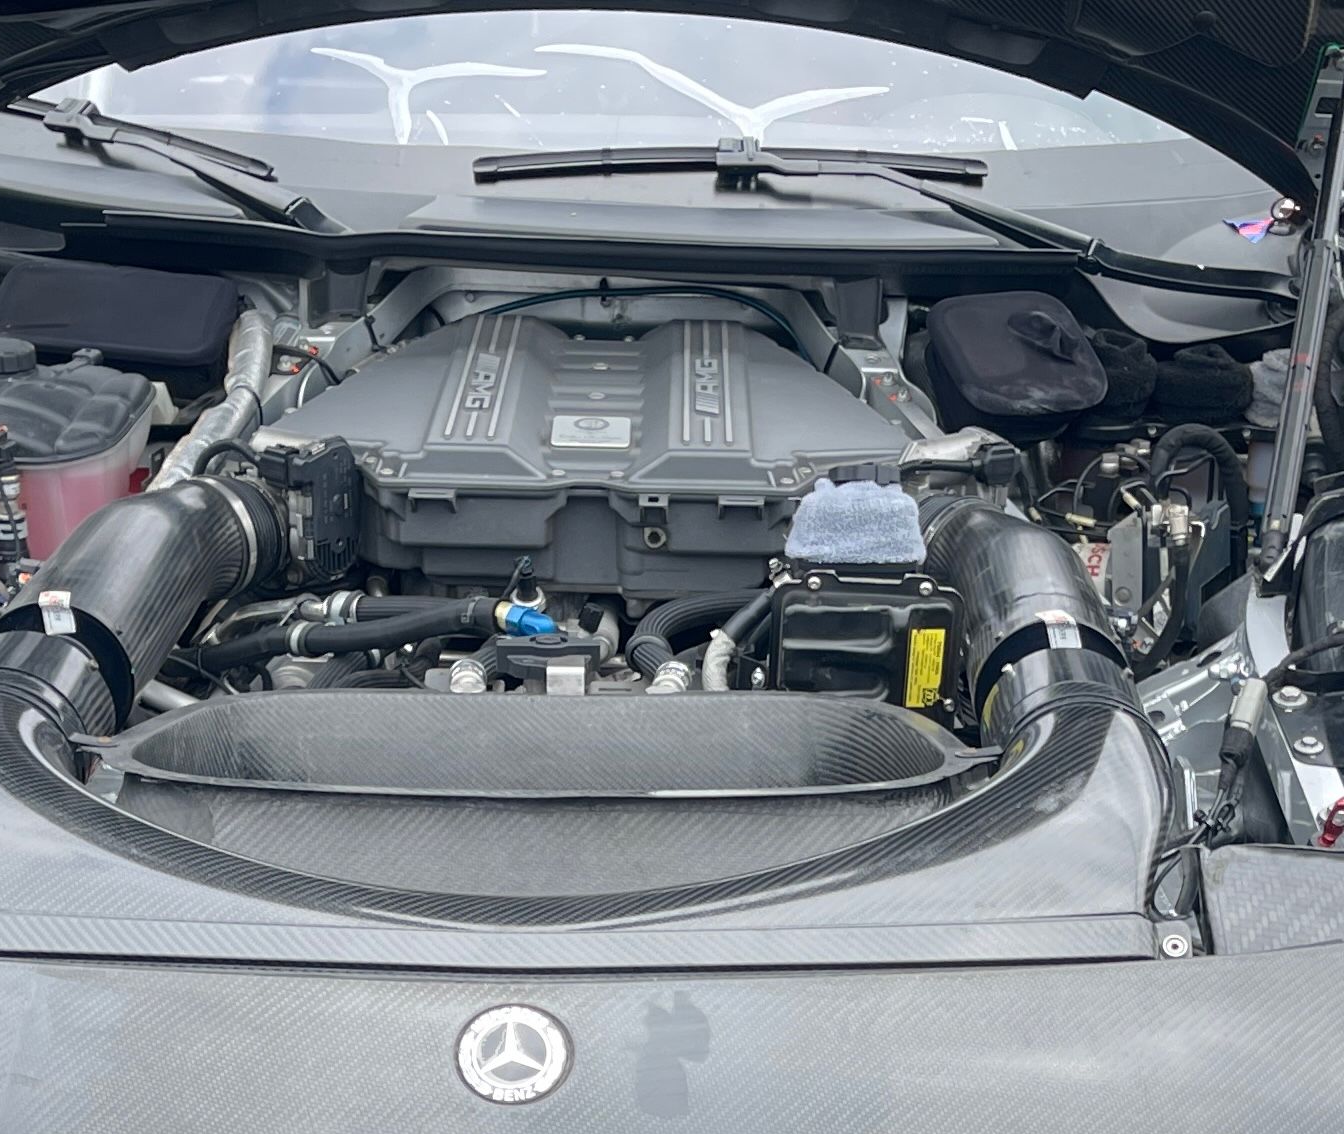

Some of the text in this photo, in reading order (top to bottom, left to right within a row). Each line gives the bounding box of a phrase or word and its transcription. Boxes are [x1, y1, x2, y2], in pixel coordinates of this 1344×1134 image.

[464, 368, 497, 409] AMG
[695, 358, 719, 395] AMG
[1087, 545, 1106, 577] SCH
[492, 1086, 537, 1102] BENZ
